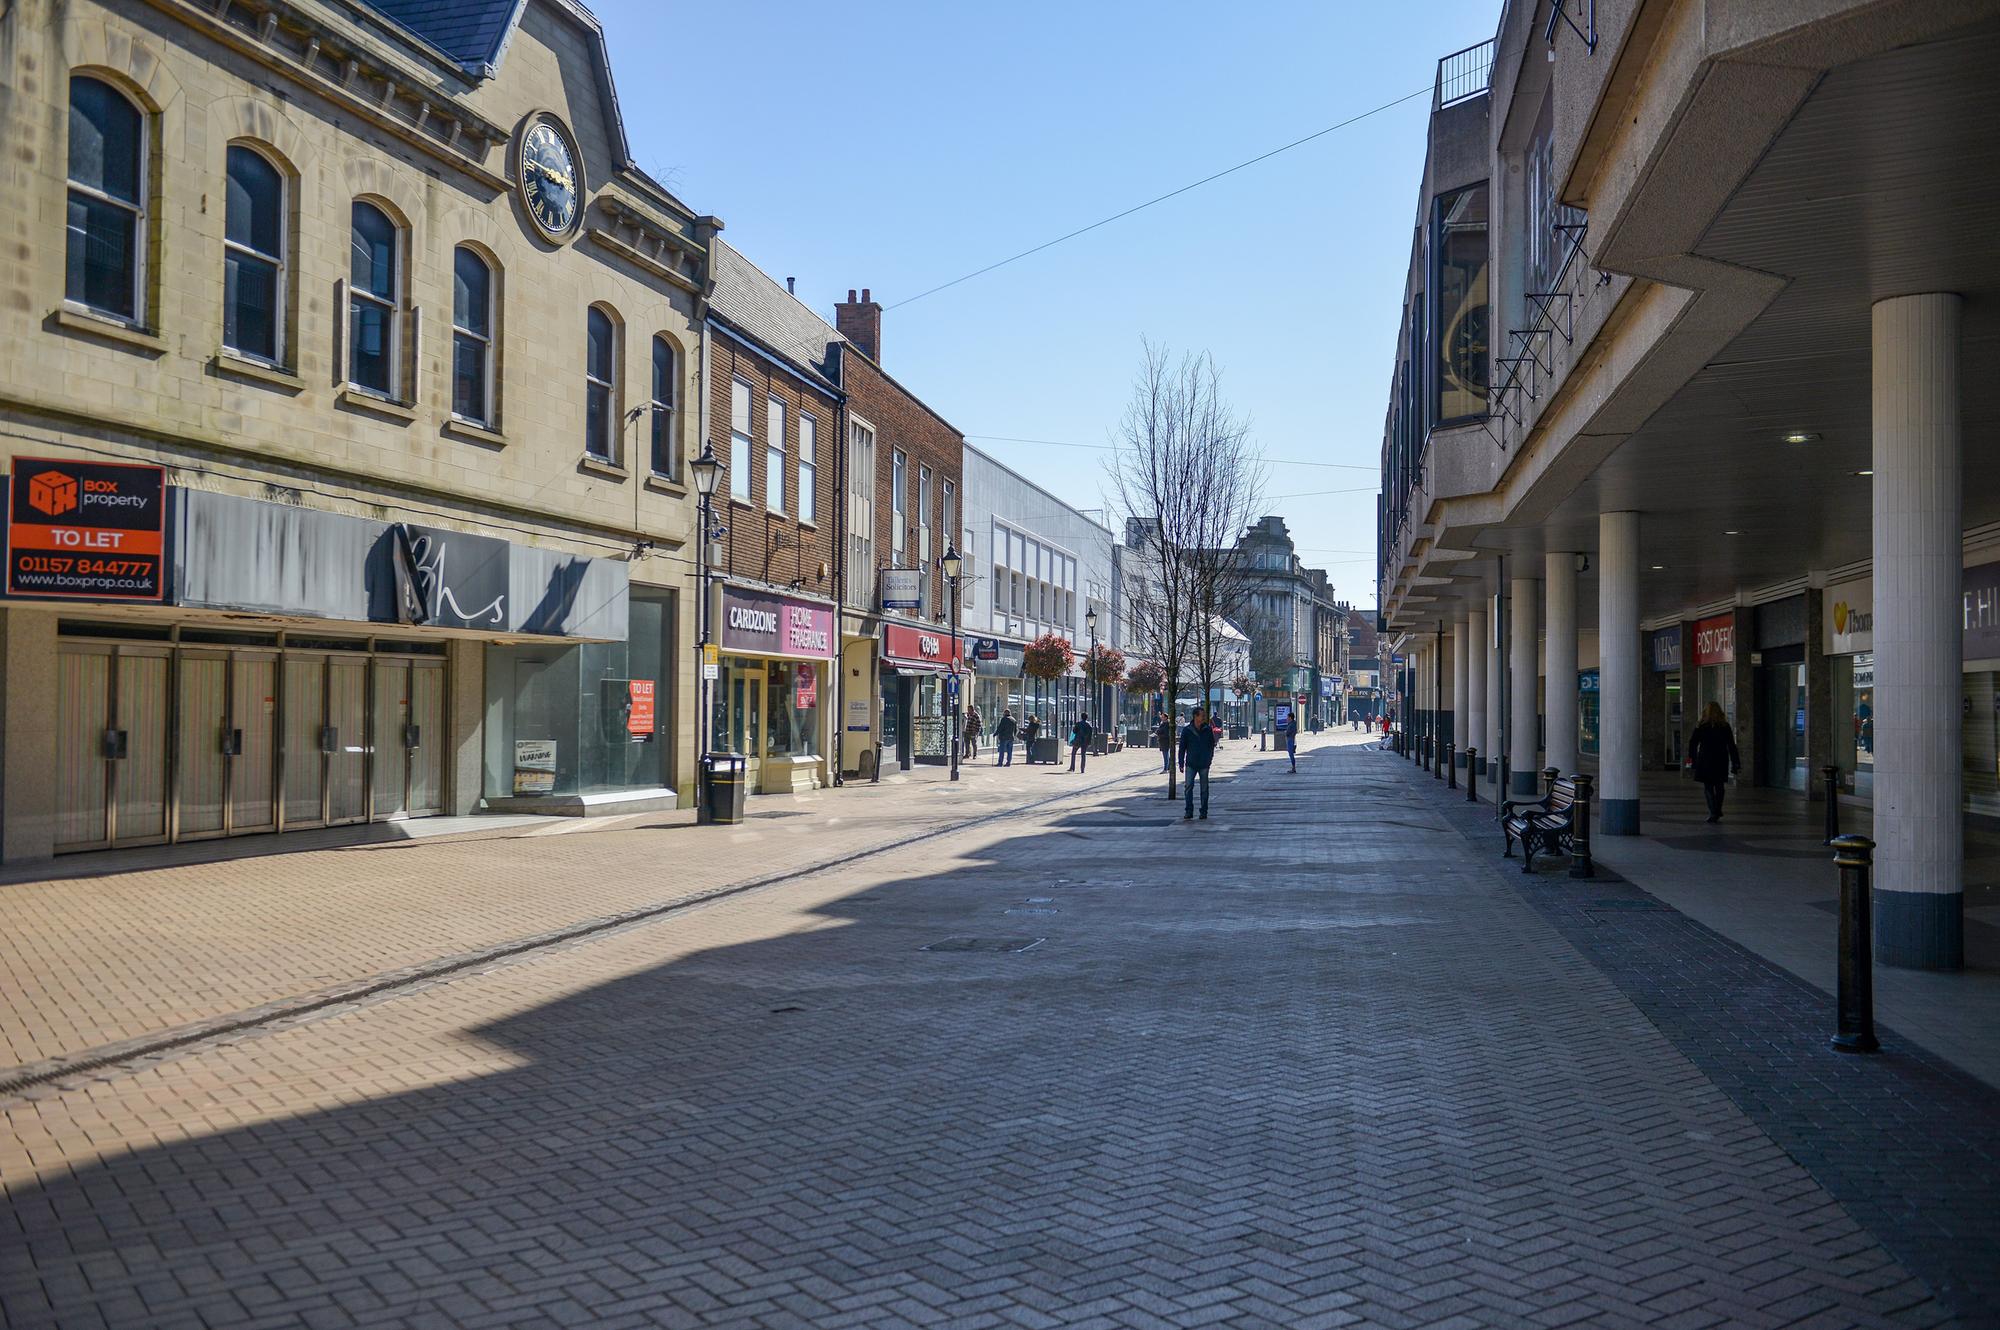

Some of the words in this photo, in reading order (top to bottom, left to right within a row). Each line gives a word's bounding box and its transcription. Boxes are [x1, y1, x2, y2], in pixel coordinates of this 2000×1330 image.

[84, 480, 118, 493] BOX
[84, 493, 148, 509] property
[51, 529, 81, 545] TO
[85, 531, 124, 548] LET
[19, 556, 74, 573] 01157
[77, 559, 153, 576] 844777
[18, 574, 153, 589] www.boxprop.co.uk
[729, 606, 777, 633] CARDZONE
[791, 606, 812, 627] HOME
[1847, 608, 1873, 633] Thom
[791, 628, 828, 650] FRAGRANCE
[1697, 630, 1713, 654] POST
[632, 683, 642, 694] TO
[642, 683, 654, 694] LET
